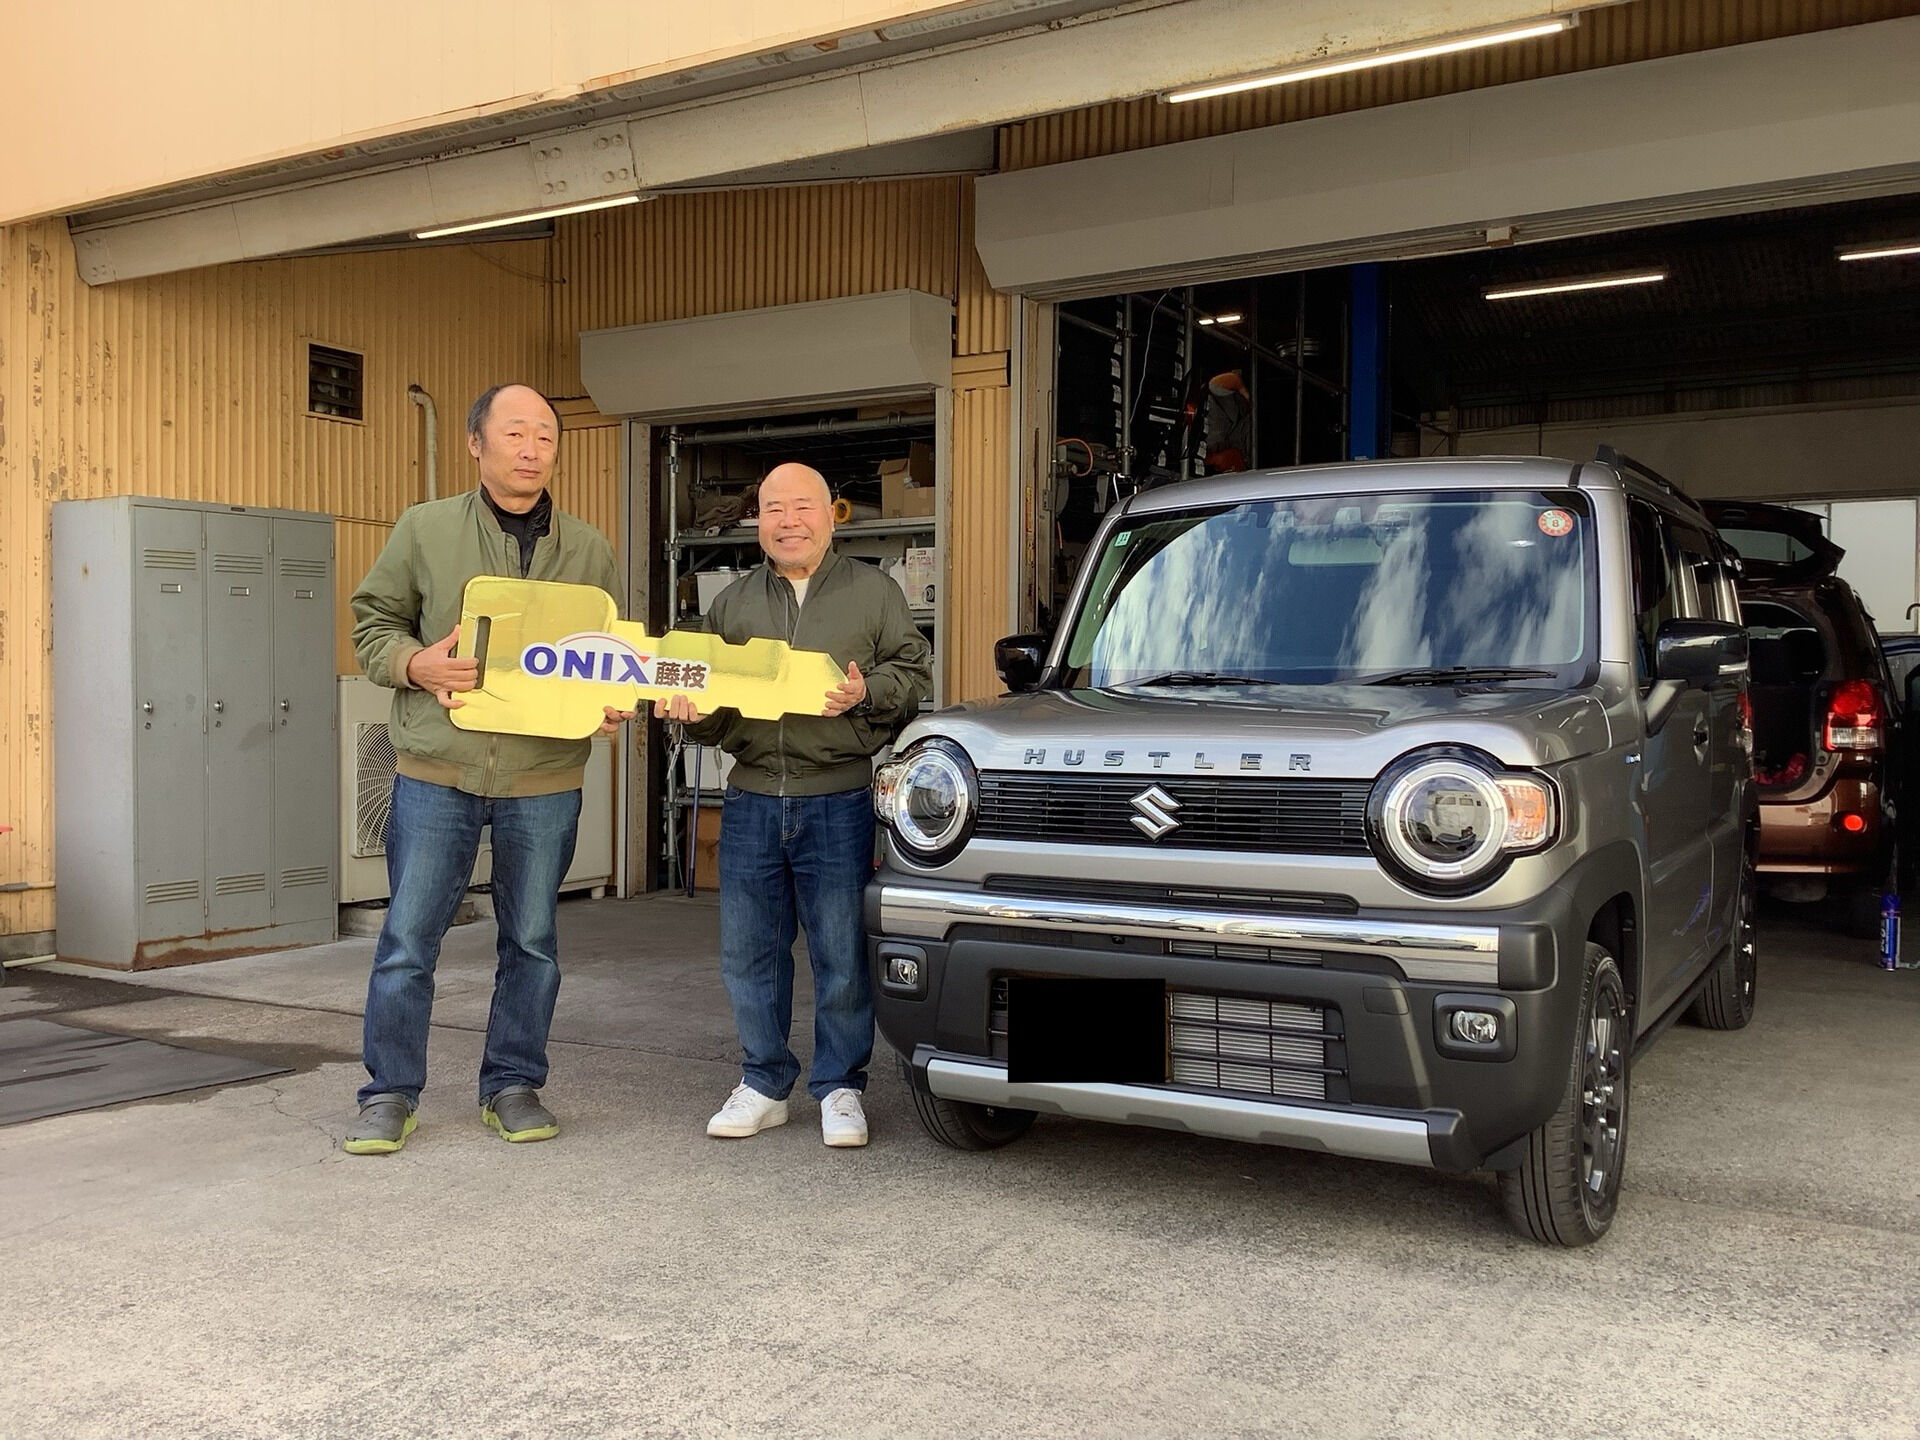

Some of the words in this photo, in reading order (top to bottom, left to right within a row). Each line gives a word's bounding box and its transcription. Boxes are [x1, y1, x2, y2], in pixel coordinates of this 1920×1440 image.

[524, 646, 650, 684] ONIX
[655, 661, 707, 688] 藤枝
[1024, 748, 1312, 771] HUSTLER
